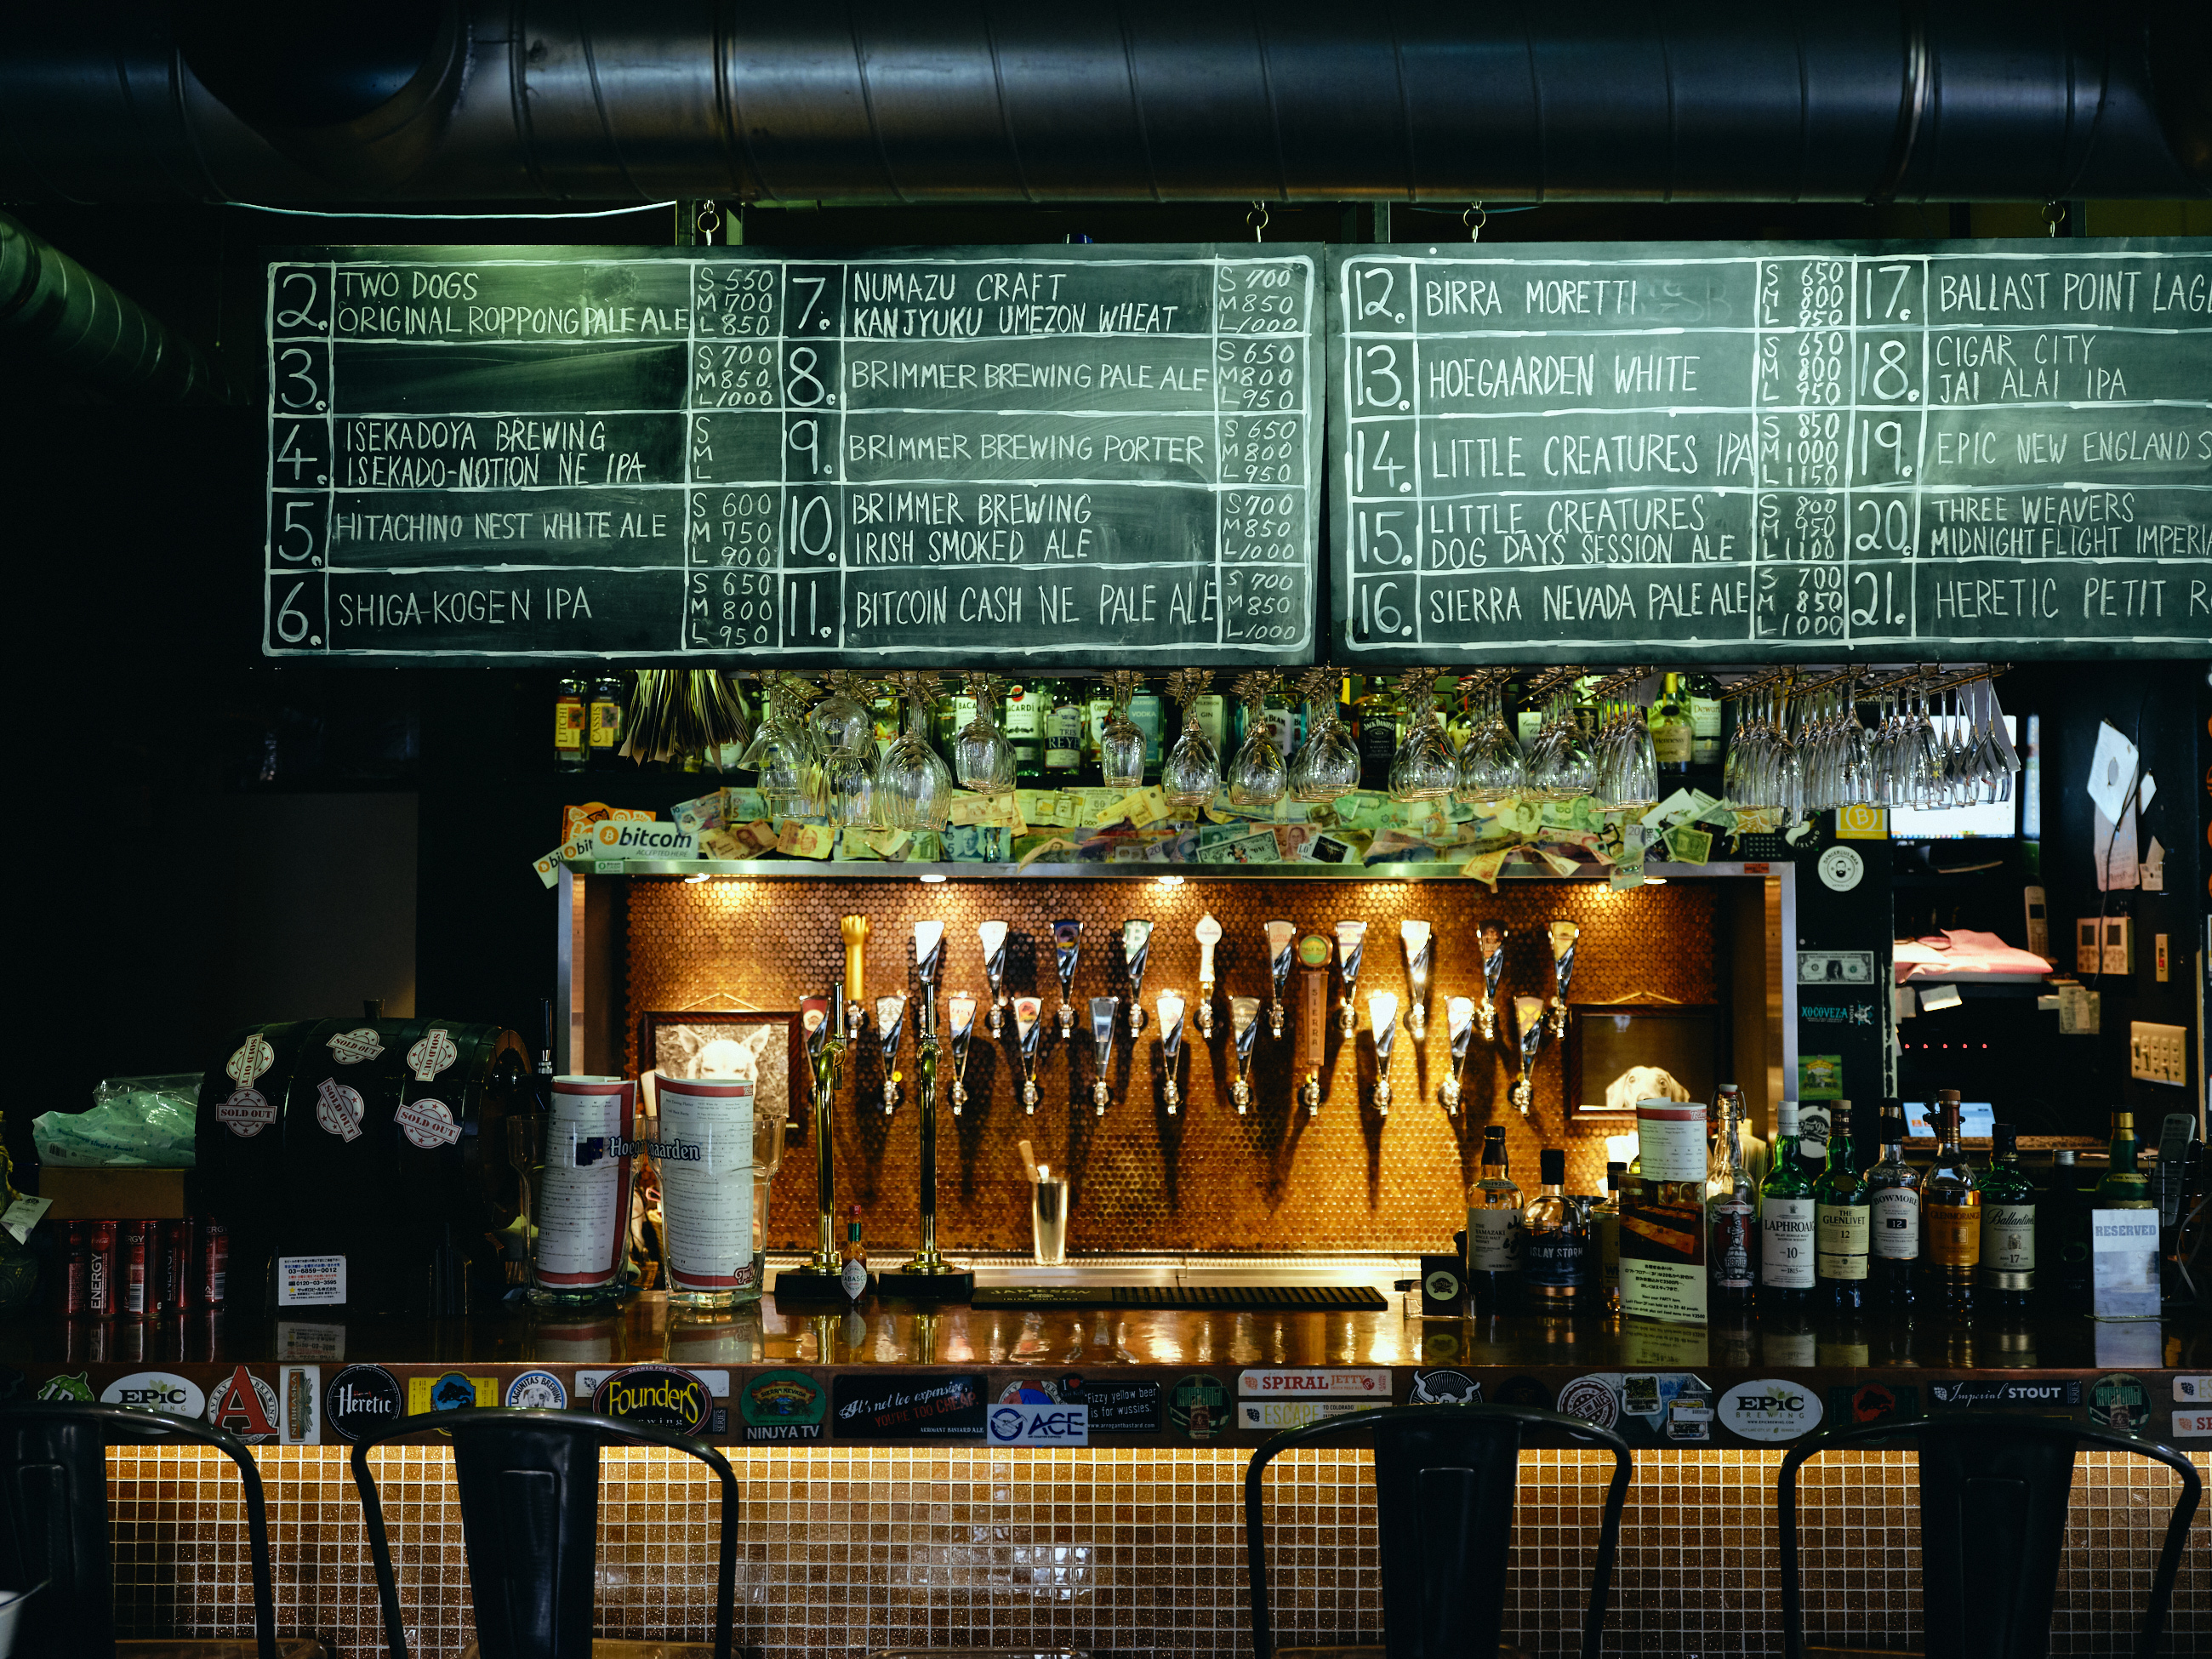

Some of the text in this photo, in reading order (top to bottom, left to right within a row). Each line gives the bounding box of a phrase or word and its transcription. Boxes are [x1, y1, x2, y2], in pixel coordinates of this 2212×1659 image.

[339, 271, 479, 300] TWO DOGS
[853, 271, 1067, 303] NUMAZU CRAFT
[1426, 279, 1637, 317] BIRRA MORETTI
[1941, 273, 2051, 312] BALLAST
[2064, 271, 2141, 313] POINT
[339, 306, 689, 335] ORIGINAL PALE ALE
[853, 302, 1179, 338] KANJYUKU UMEZON WHEAT
[1936, 334, 2096, 367] CIGAR CITY
[852, 361, 1209, 391] BRIMMER BREWING PALE ALE
[1430, 354, 1700, 399] HOEGAARDEN WHITE
[1940, 368, 2127, 403] JAI ALAI IPA
[346, 419, 606, 452] ISEKADOYA BREWING
[849, 433, 1204, 465] BRIMMER BREWING PORTER
[1938, 430, 2190, 465] EPIC NEW ENGLAND
[348, 452, 646, 488] ISEKADO-NOTION NE IPA
[1434, 431, 1754, 478] LITTLE CREATURES IPA
[852, 491, 1092, 526] BRIMMER BREWING
[1431, 494, 1704, 536] LITTLE CREATURES
[1931, 492, 2135, 524] THREE WEAVERS
[337, 512, 666, 542] HITACHINO NEST WHITE ALE
[1930, 526, 2035, 557] MIDNIGHT
[2042, 525, 2123, 557] FLIGHT
[856, 528, 1093, 564] IRISH SMOKED ALE
[1432, 533, 1736, 569] DOG DAYS SESSION ALE
[340, 586, 592, 627] SHIGA-KOGEN IPA
[856, 579, 1217, 628] BITCOIN CASH NE PALE ALE
[1430, 581, 1749, 624] SIERRA NEVADA PALE ALE
[1937, 577, 2167, 619] HERETIC PETIT
[558, 707, 567, 743] LITCHI
[592, 706, 601, 743] CASSIS
[1801, 1006, 1849, 1019] XOCOVEZA
[242, 1038, 258, 1086] SOLD OUT
[334, 1037, 377, 1056] SOLD OUT
[422, 1032, 442, 1078] SOLD OUT
[220, 1109, 272, 1119] SOLD OUT
[324, 1084, 356, 1137] SOLD OUT
[400, 1110, 456, 1137] SOLD OUT
[1873, 1194, 1918, 1206] BOWMORE
[1822, 1215, 1866, 1225] GLENLIVET
[1840, 1230, 1850, 1239] 12
[2095, 1225, 2157, 1237] RESERVED
[1530, 1246, 1583, 1258] ISLAY STORM
[1787, 1247, 1798, 1258] 10
[2010, 1254, 2020, 1263] 17
[90, 1253, 103, 1309] ENERGY
[512, 1376, 562, 1405] LAGUNITAS BREWING
[1263, 1376, 1329, 1390] SPIRAL
[1331, 1374, 1366, 1386] JETTY
[1948, 1382, 2062, 1407] Imperial STOUT
[334, 1382, 392, 1417] Heretic
[1091, 1401, 1155, 1418] is for wussies."
[1264, 1404, 1320, 1425] ESCAPE
[747, 1424, 819, 1440] NINJYA TV
[1027, 1412, 1086, 1435] ACE
